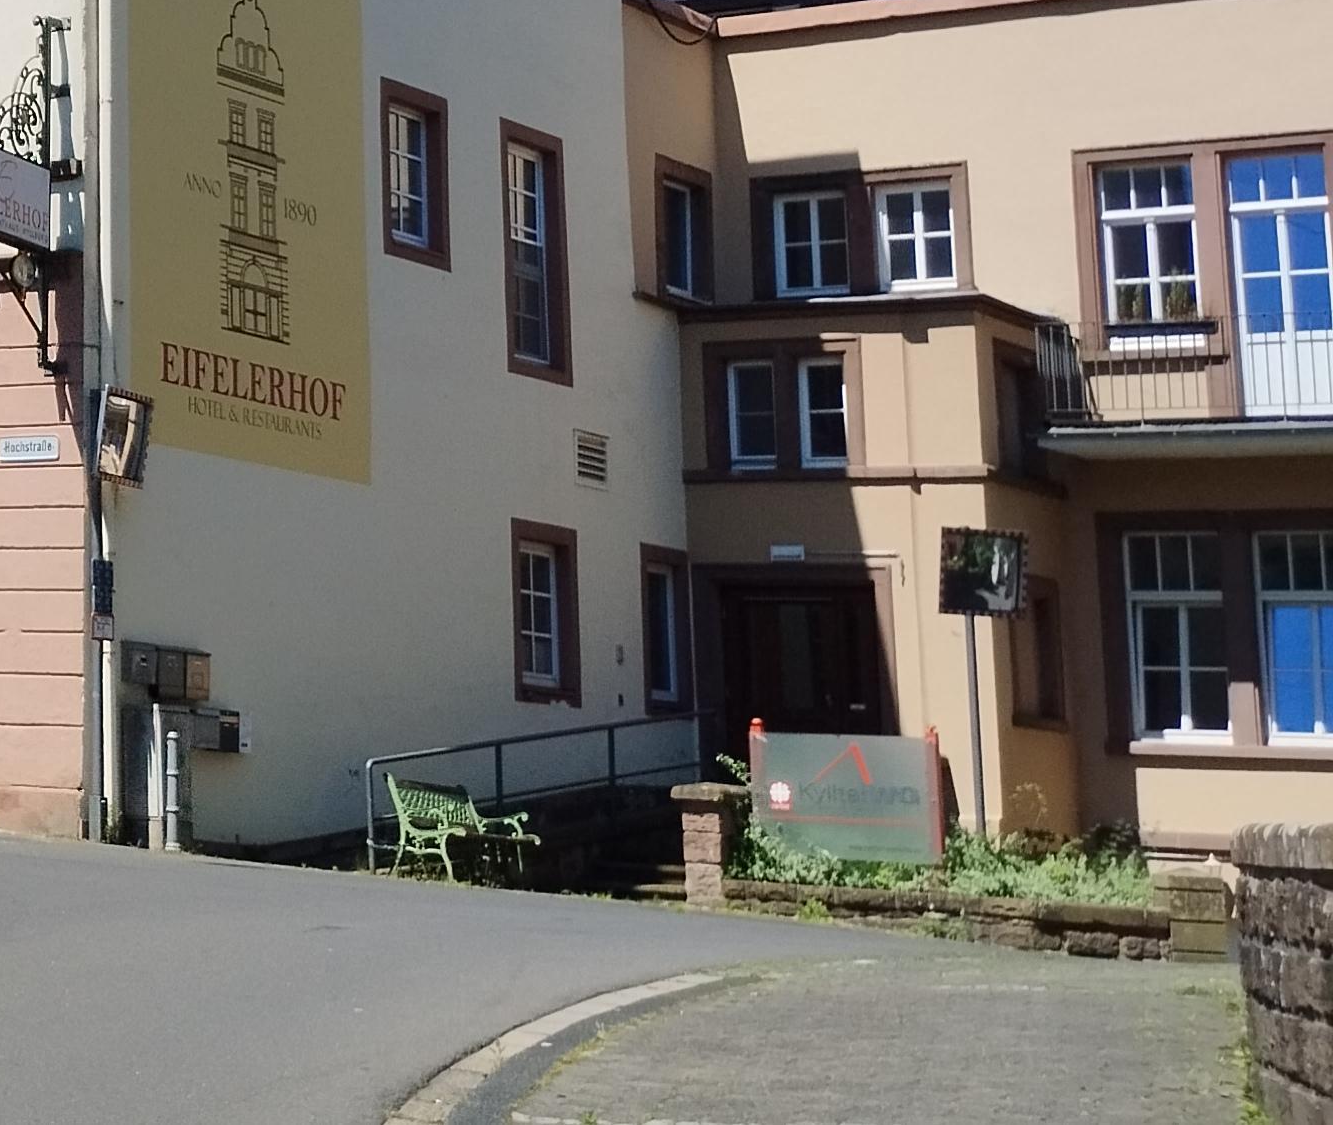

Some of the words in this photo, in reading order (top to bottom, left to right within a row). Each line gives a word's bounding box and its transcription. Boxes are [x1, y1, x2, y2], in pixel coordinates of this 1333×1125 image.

[184, 172, 222, 199] ANNO
[284, 197, 317, 226] 1890
[160, 341, 346, 421] EIFELERHOF
[188, 395, 227, 421] HOTEL
[228, 407, 239, 423] &
[242, 407, 323, 440] RESTAURANTS
[4, 439, 52, 453] Hochstraße
